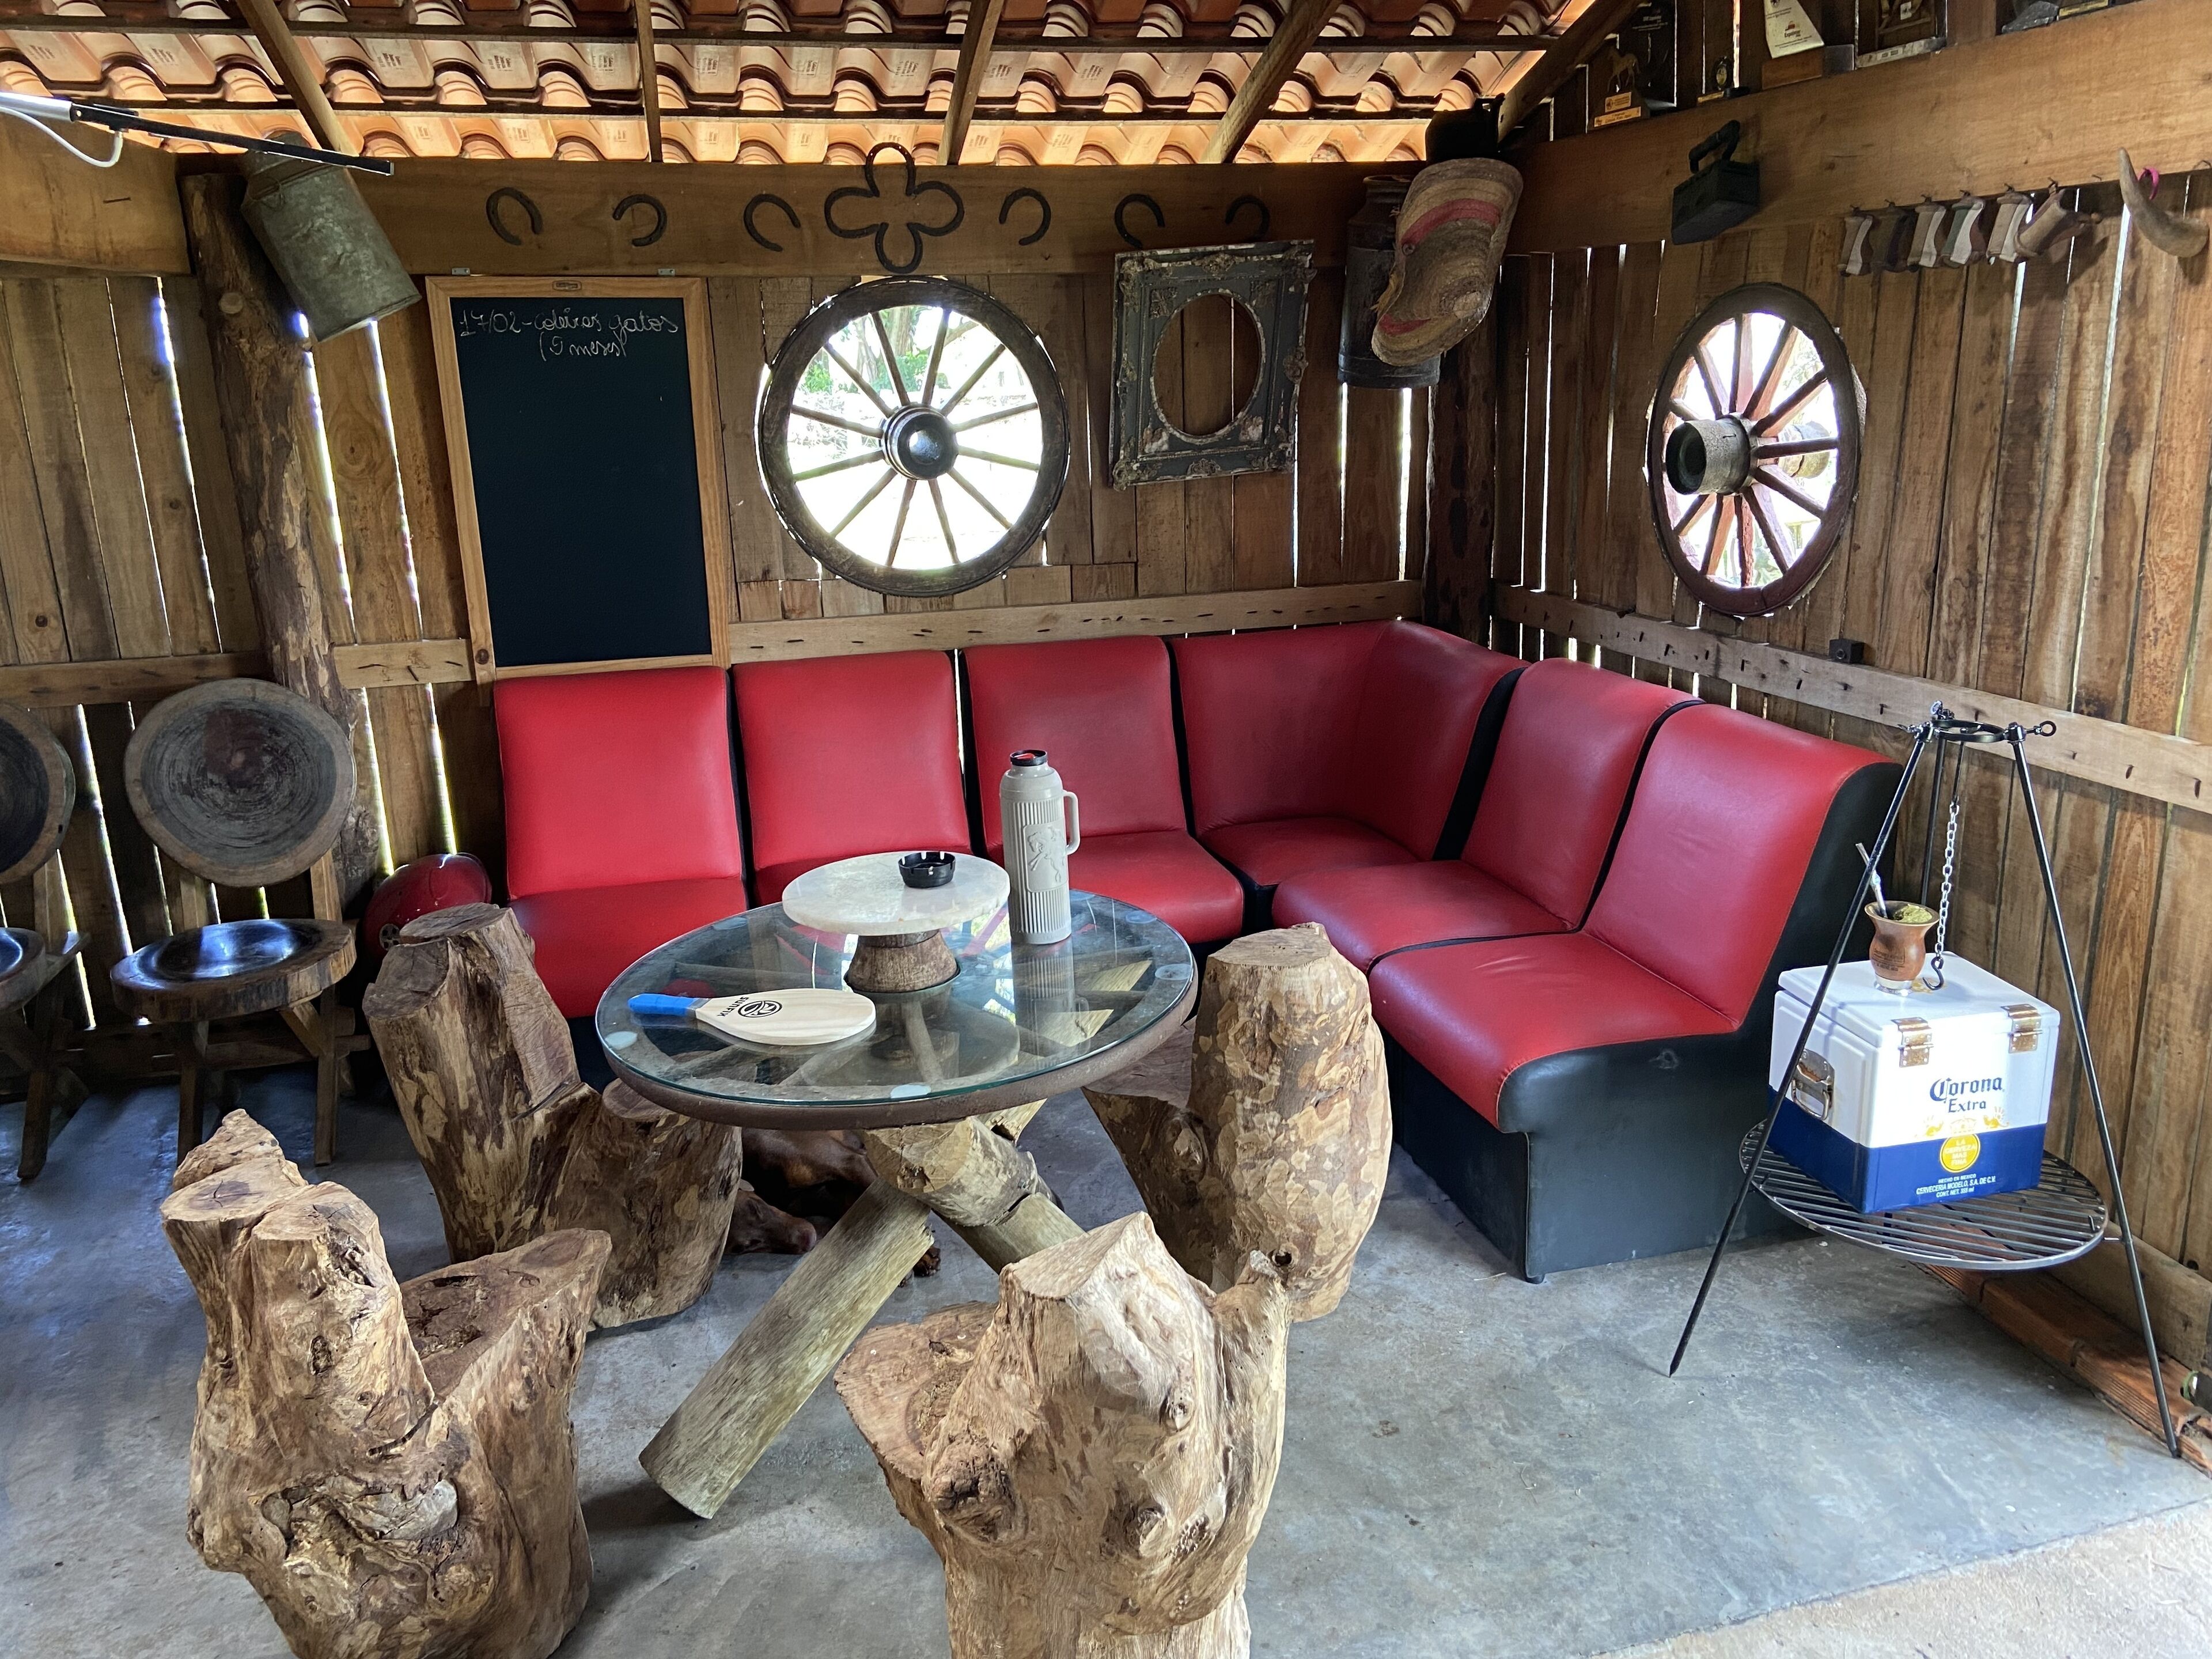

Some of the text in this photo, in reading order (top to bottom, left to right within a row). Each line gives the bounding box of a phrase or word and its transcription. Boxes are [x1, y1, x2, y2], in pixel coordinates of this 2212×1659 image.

[1930, 1077, 2003, 1104] Corona
[1948, 1098, 1986, 1113] Extra
[1956, 1138, 1967, 1146] LA
[1916, 1184, 1947, 1195] CERVECERIA
